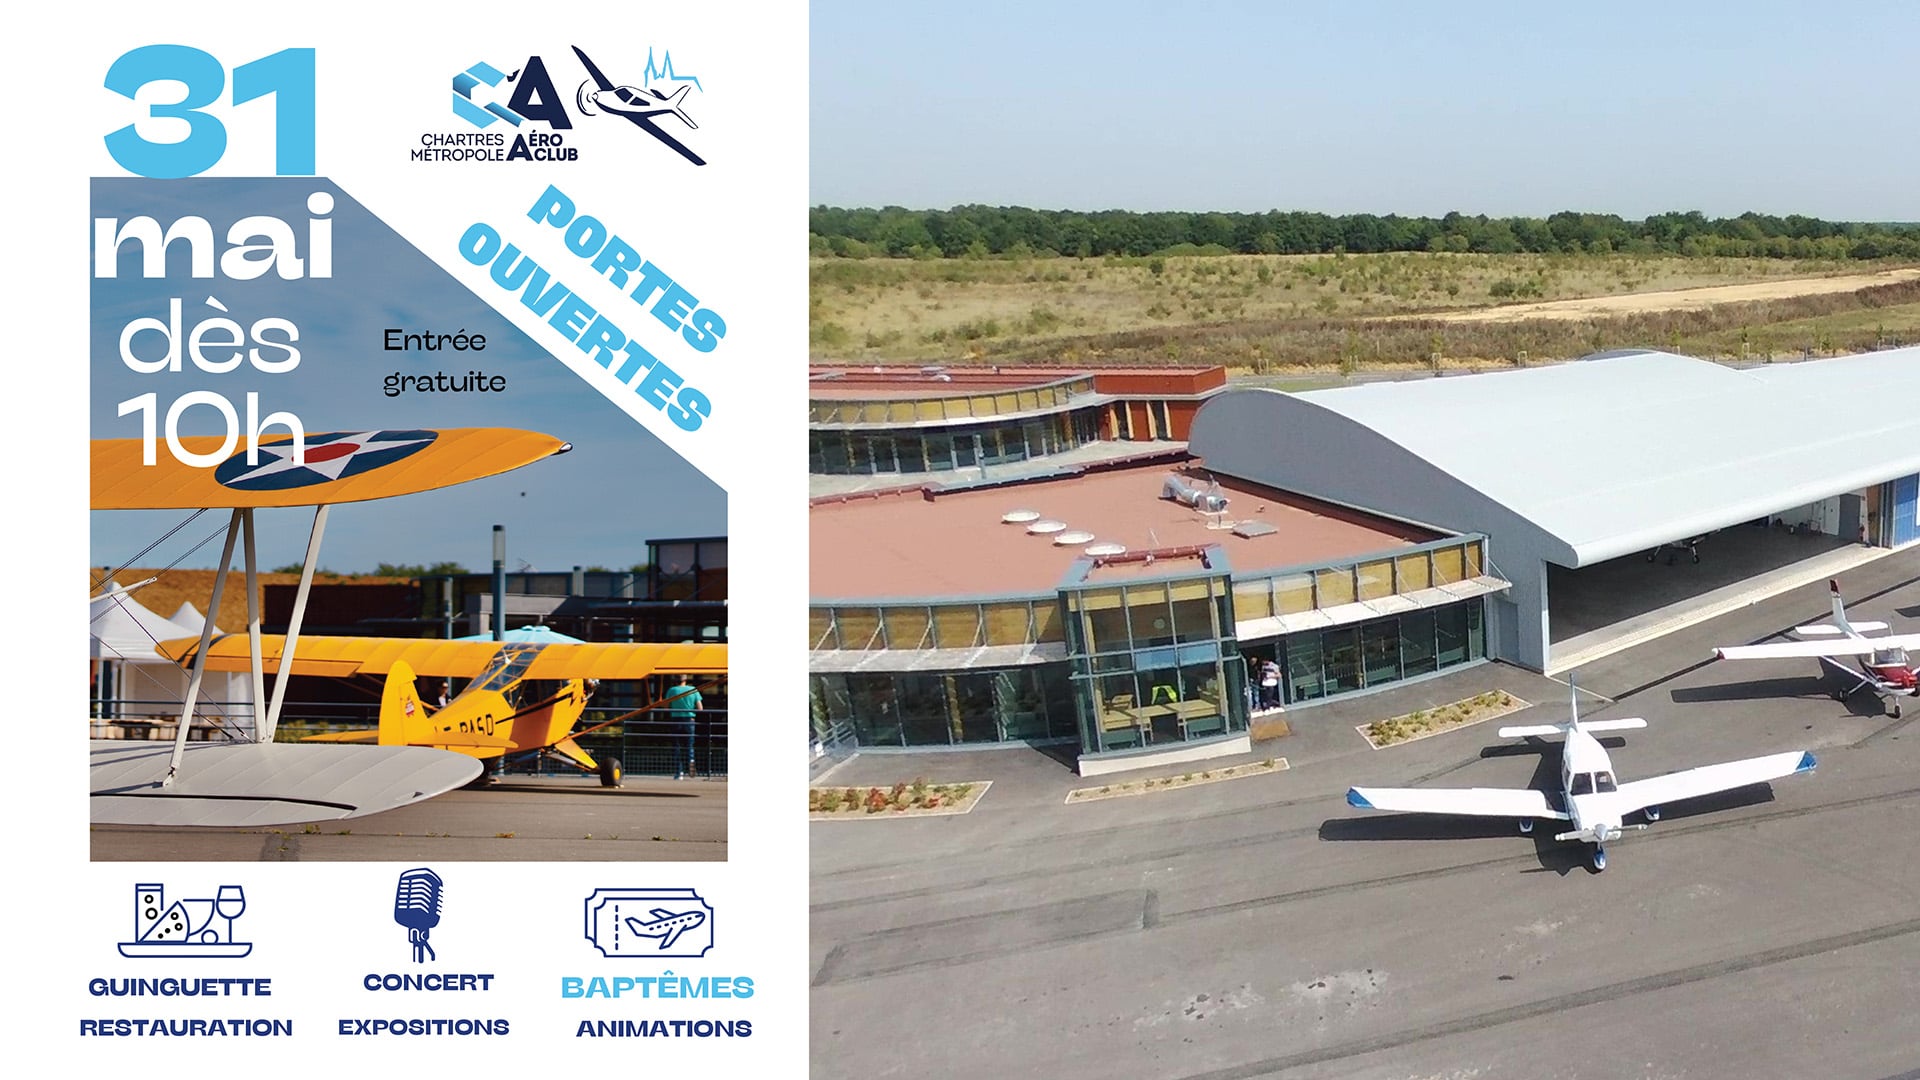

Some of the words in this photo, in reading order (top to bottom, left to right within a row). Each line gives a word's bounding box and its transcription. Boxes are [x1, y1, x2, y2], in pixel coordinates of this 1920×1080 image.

[103, 43, 316, 179] 31
[411, 146, 504, 162] MÉTROPOLE
[534, 148, 579, 162] CLUB
[421, 133, 504, 146] CHARTRES
[506, 130, 563, 161] AÉRO
[94, 192, 335, 280] mai
[527, 184, 727, 353] PORTES
[119, 295, 301, 374] dès
[383, 328, 487, 351] Entrée
[458, 222, 712, 432] OUVERTES
[383, 370, 507, 398] gratuite
[117, 390, 305, 468] 10h
[88, 977, 272, 997] GUINGUETTE
[363, 973, 495, 992] CONCERT
[561, 969, 755, 999] BAPTÊMES
[79, 1018, 293, 1037] RESTAURATION
[338, 1018, 510, 1036] EXPOSITIONS
[575, 1019, 753, 1038] ANIMATIONS
